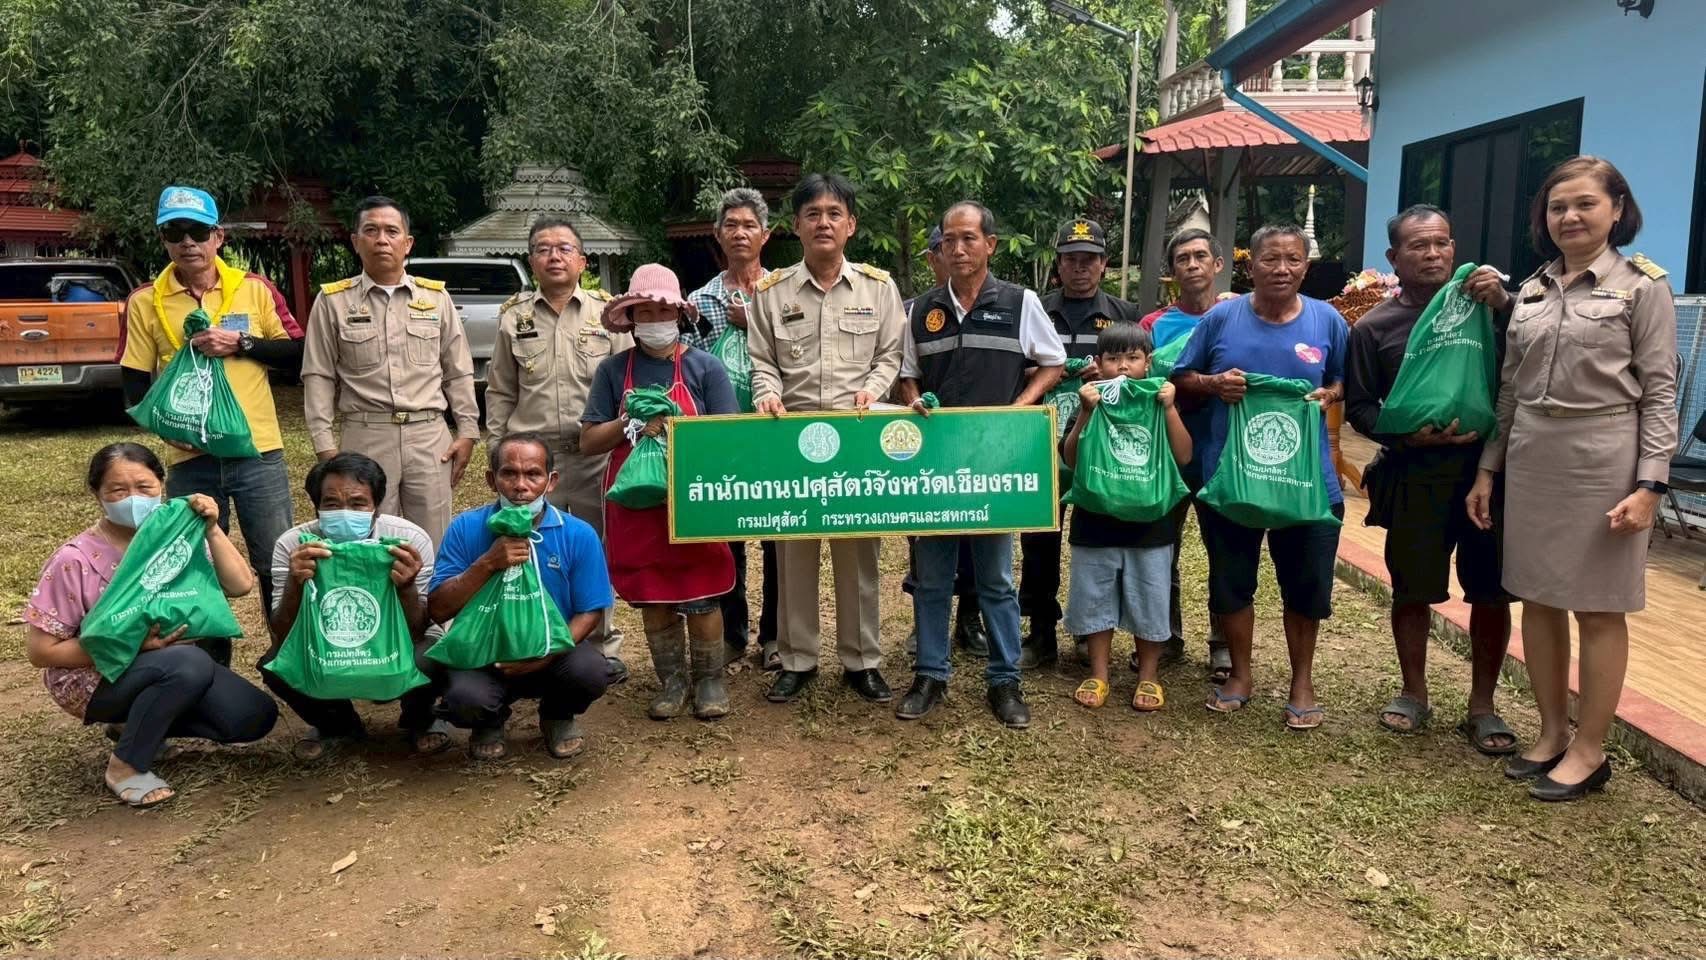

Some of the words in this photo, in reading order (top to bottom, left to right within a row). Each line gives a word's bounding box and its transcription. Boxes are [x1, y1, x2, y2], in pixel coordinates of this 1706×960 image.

[37, 366, 60, 376] 4224
[688, 467, 1039, 506] สำนักงานปศุสัตว์จังหวัดเชียงราย
[737, 509, 807, 532] กรมปศุสัตว์
[821, 504, 990, 526] กระทรวงเกษตรและสหกรณ์
